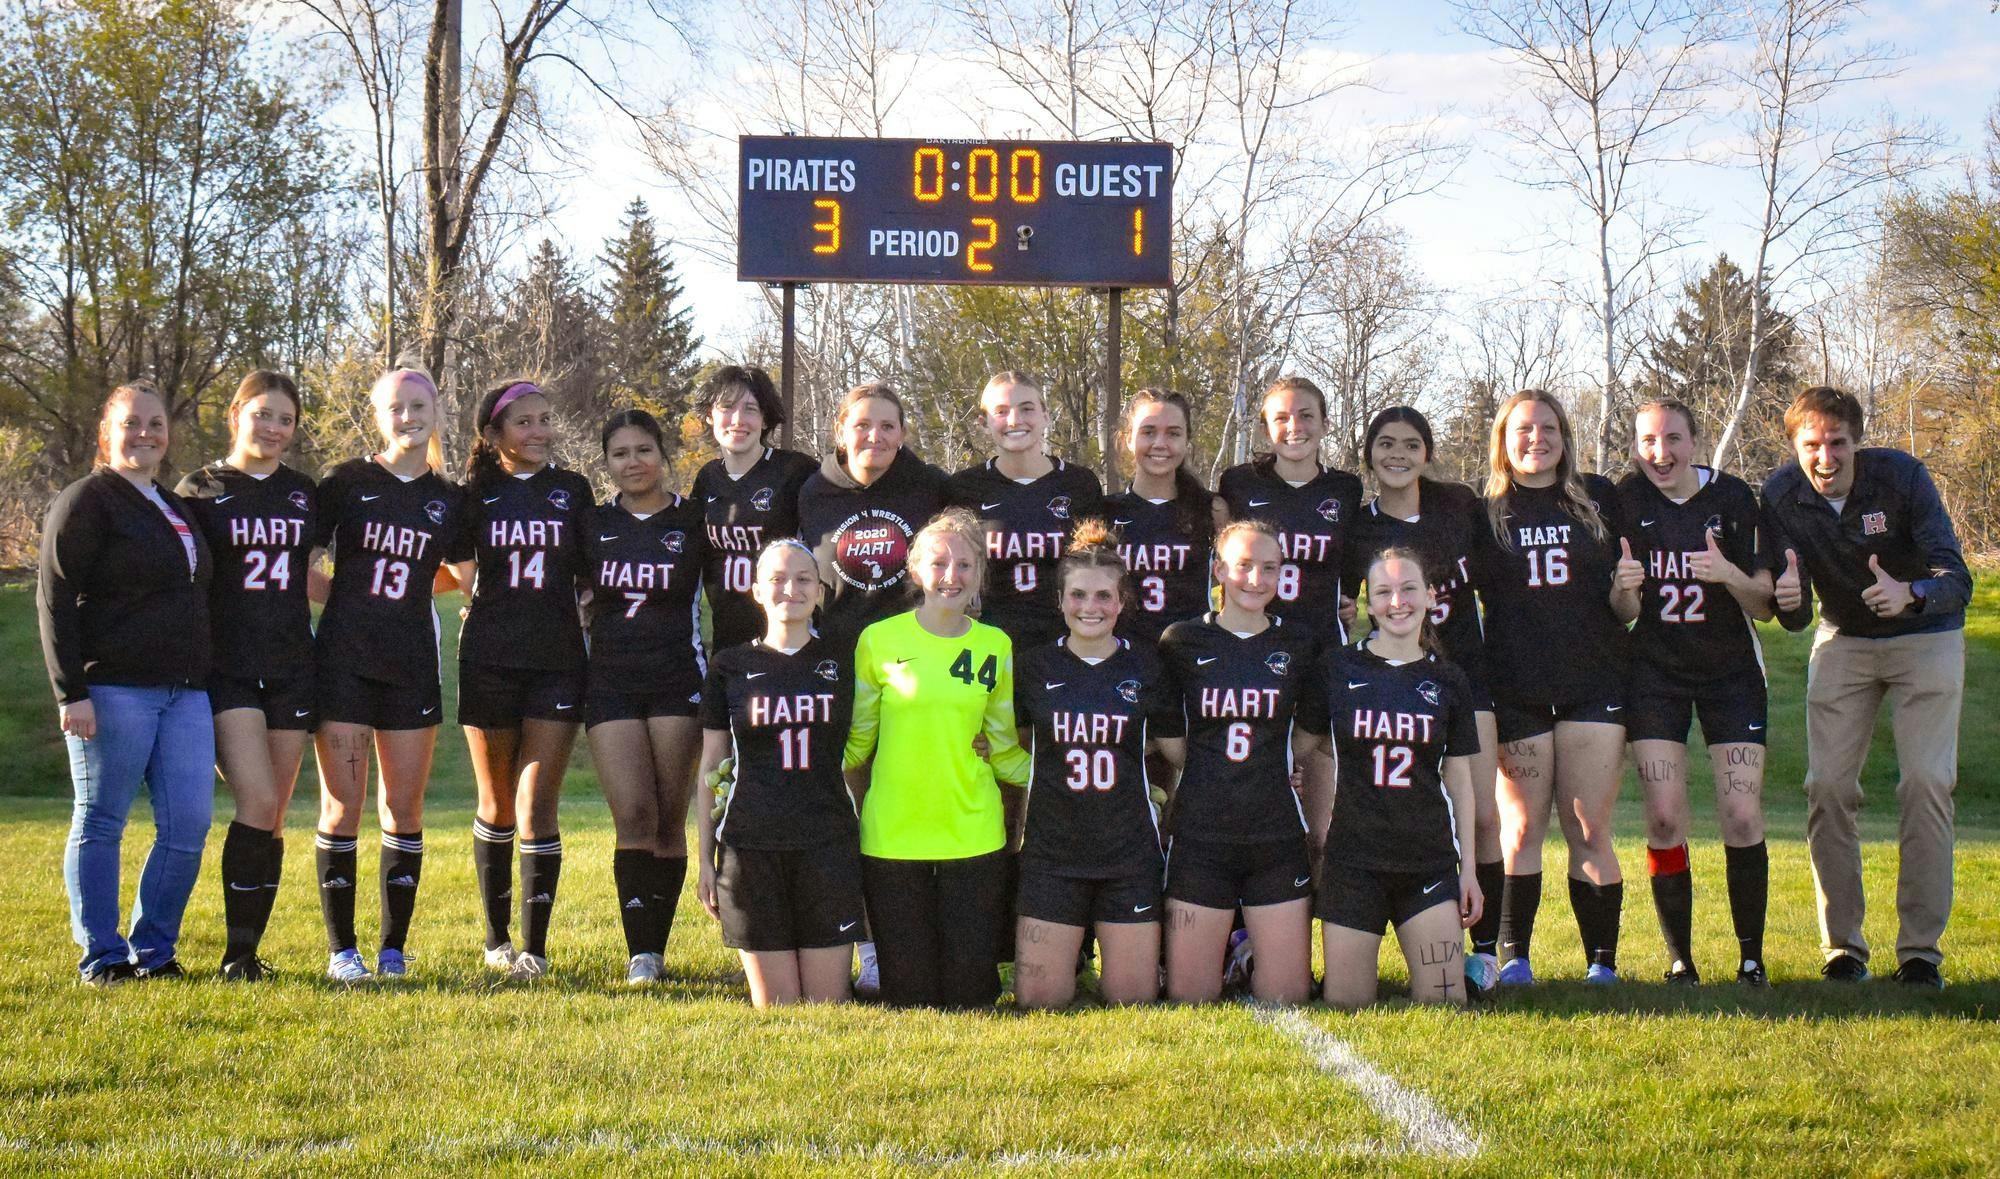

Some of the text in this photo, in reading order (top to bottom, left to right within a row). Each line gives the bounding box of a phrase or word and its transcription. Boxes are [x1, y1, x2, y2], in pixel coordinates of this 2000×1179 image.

[925, 137, 989, 145] DAKTRONICS
[748, 158, 857, 192] PIRATES
[913, 147, 1041, 203] 0:00
[1055, 163, 1163, 198] GUEST
[813, 200, 841, 254] 3
[870, 229, 960, 257] PERIOD
[1132, 207, 1144, 257] 1
[967, 217, 998, 272] 2
[231, 518, 304, 547] HART
[491, 520, 563, 547] HART
[706, 524, 763, 551] HART
[831, 509, 914, 544] DIVISION 4 WRESTLING
[855, 528, 888, 540] 2020
[1519, 526, 1571, 547] HART
[1862, 511, 1887, 535] H
[363, 522, 432, 560] HART
[846, 540, 895, 557] HART
[986, 531, 1064, 559] HART
[1116, 543, 1191, 571] HART
[1278, 532, 1331, 562] ART
[243, 550, 290, 590] 24
[371, 557, 411, 600] 13
[508, 550, 546, 589] 14
[600, 561, 674, 590] HART
[724, 554, 752, 593] 10
[1527, 549, 1569, 587] 16
[1650, 550, 1698, 579] HAR
[1142, 576, 1166, 612] 3
[1277, 564, 1301, 601] 8
[623, 592, 648, 619] 7
[1659, 584, 1706, 622] 22
[949, 648, 998, 693] 44
[751, 694, 834, 726] HART
[1201, 688, 1280, 718] HART
[1053, 712, 1129, 744] HART
[1226, 722, 1251, 762] 6
[1353, 709, 1434, 743] HART
[780, 728, 811, 770] 11
[1372, 745, 1413, 787] 12
[1726, 746, 1761, 768] 100%
[1066, 749, 1117, 791] 30
[1723, 770, 1757, 796] Jesu
[1419, 940, 1464, 966] LLTM
